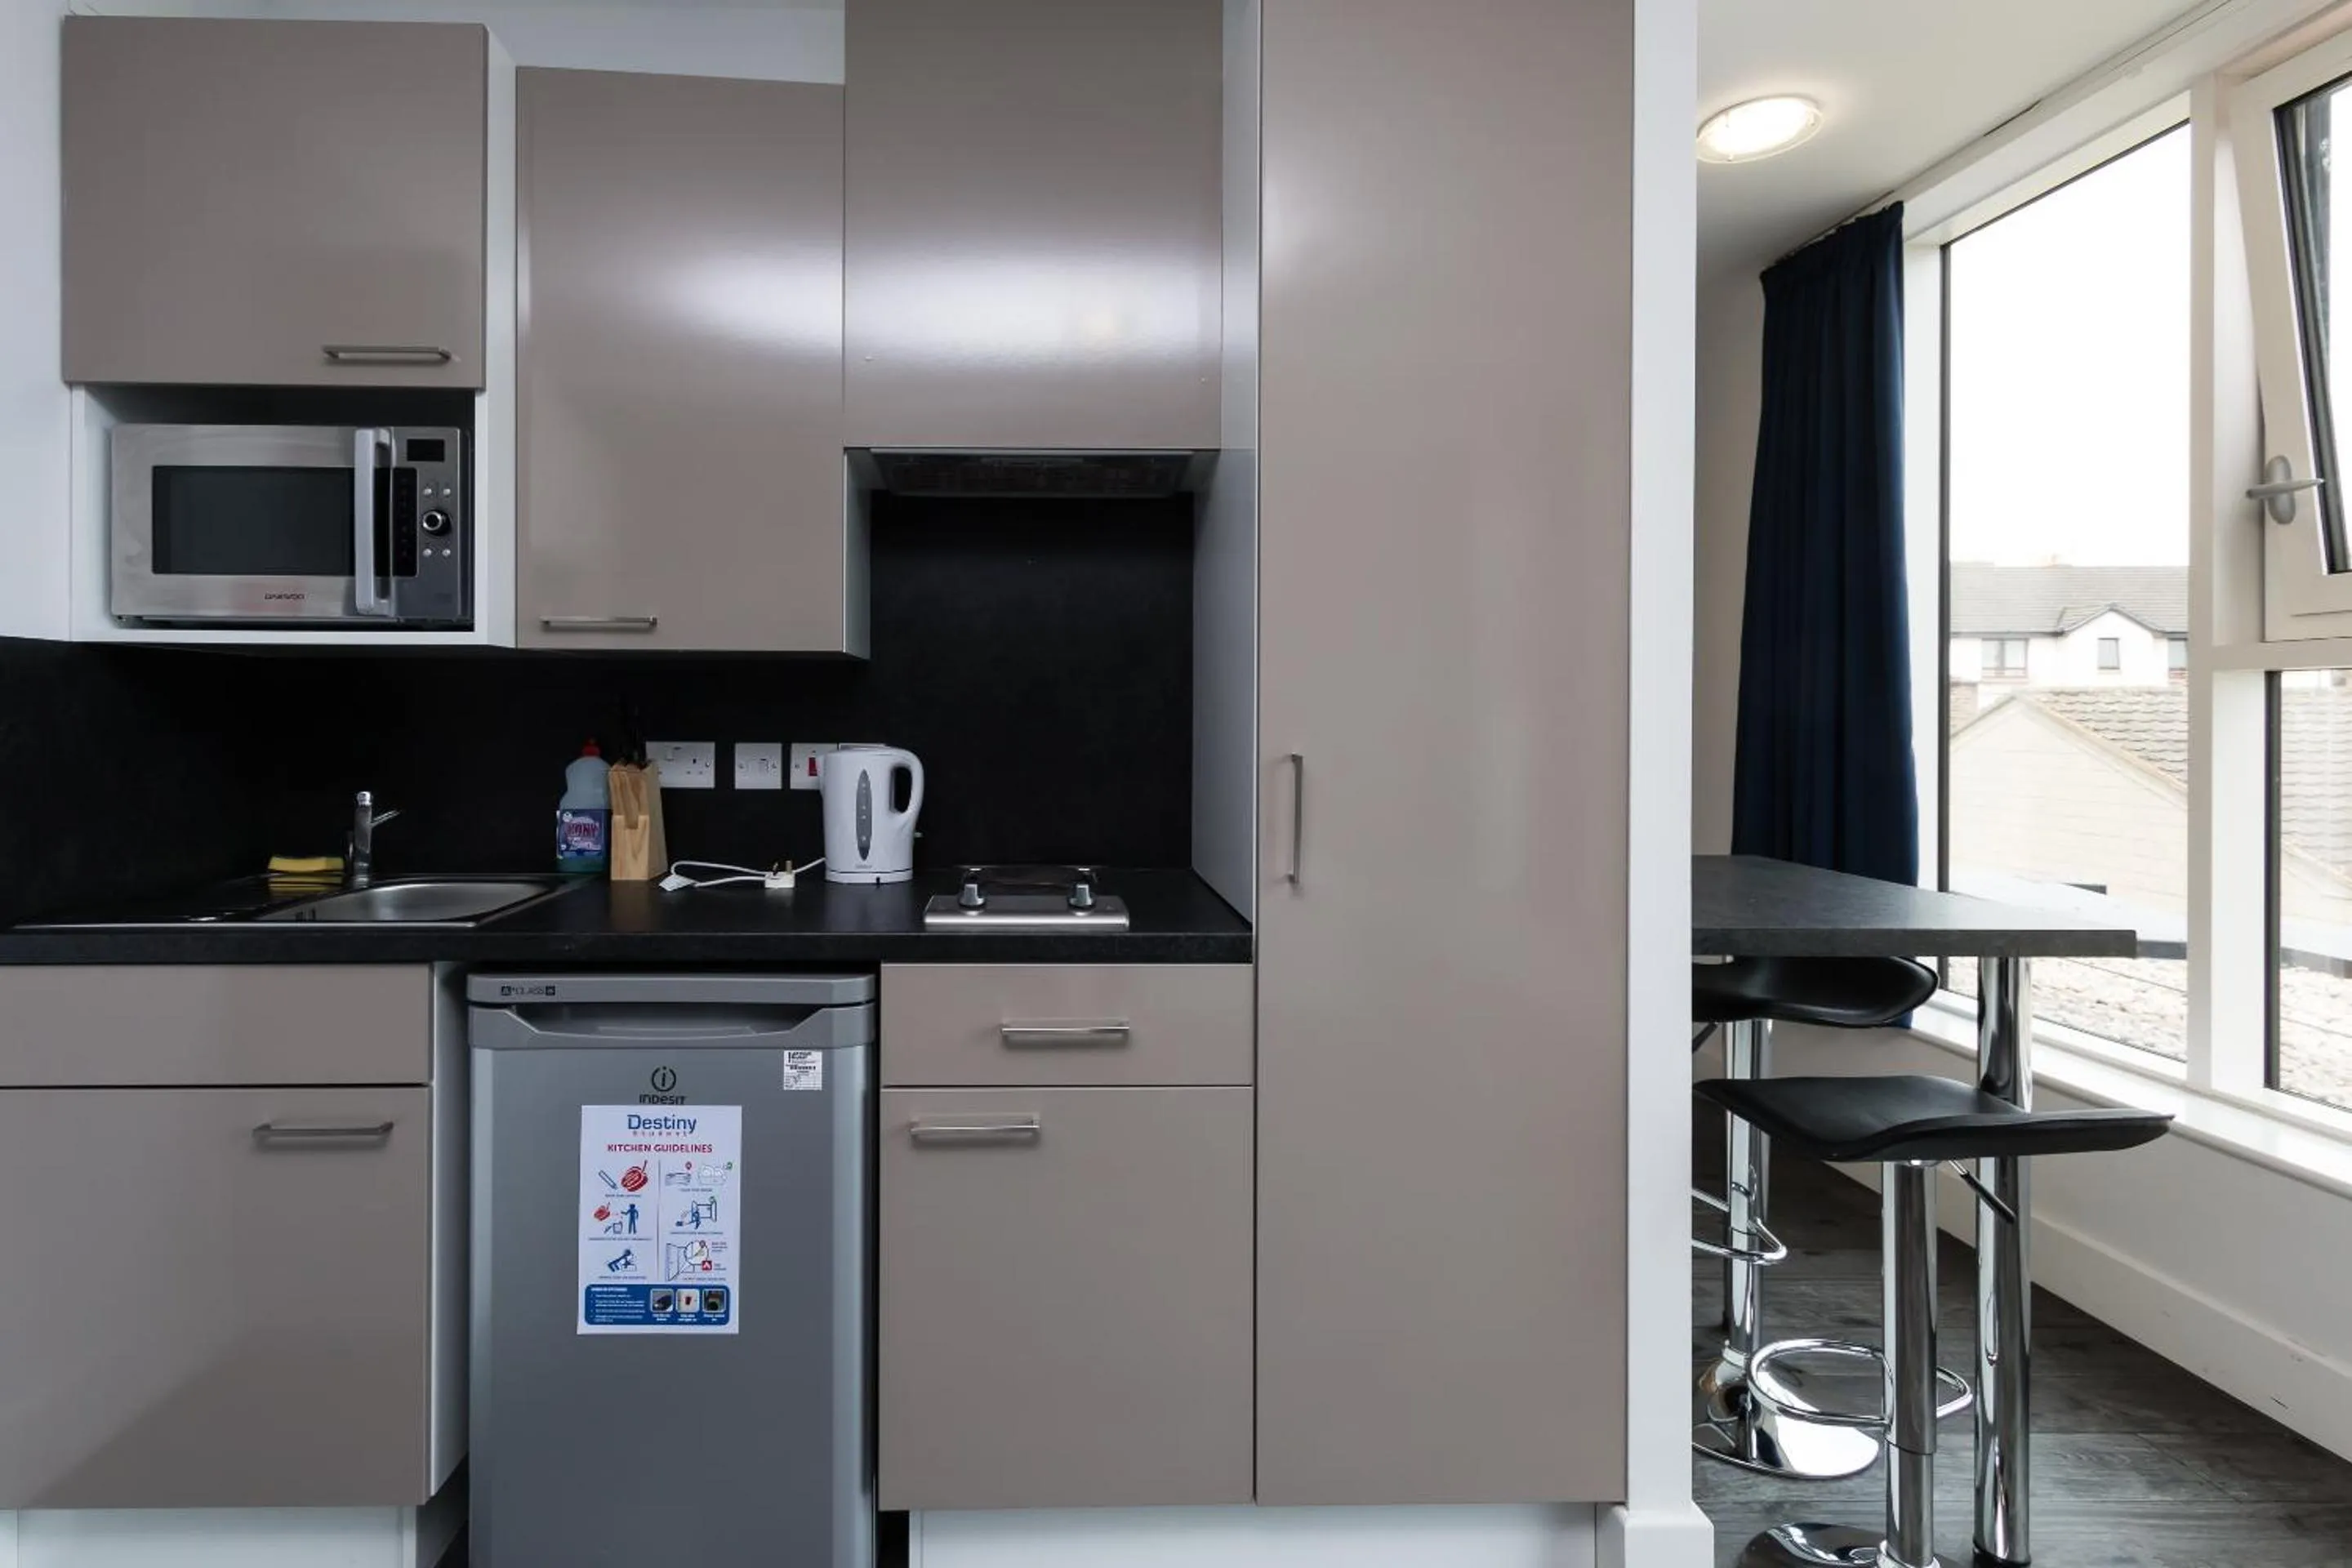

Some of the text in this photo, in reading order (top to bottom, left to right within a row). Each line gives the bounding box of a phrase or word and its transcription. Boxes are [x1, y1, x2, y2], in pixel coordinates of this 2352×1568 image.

[627, 1114, 697, 1134] Destiny
[607, 1143, 713, 1154] KITCHEN GUIDELINES
